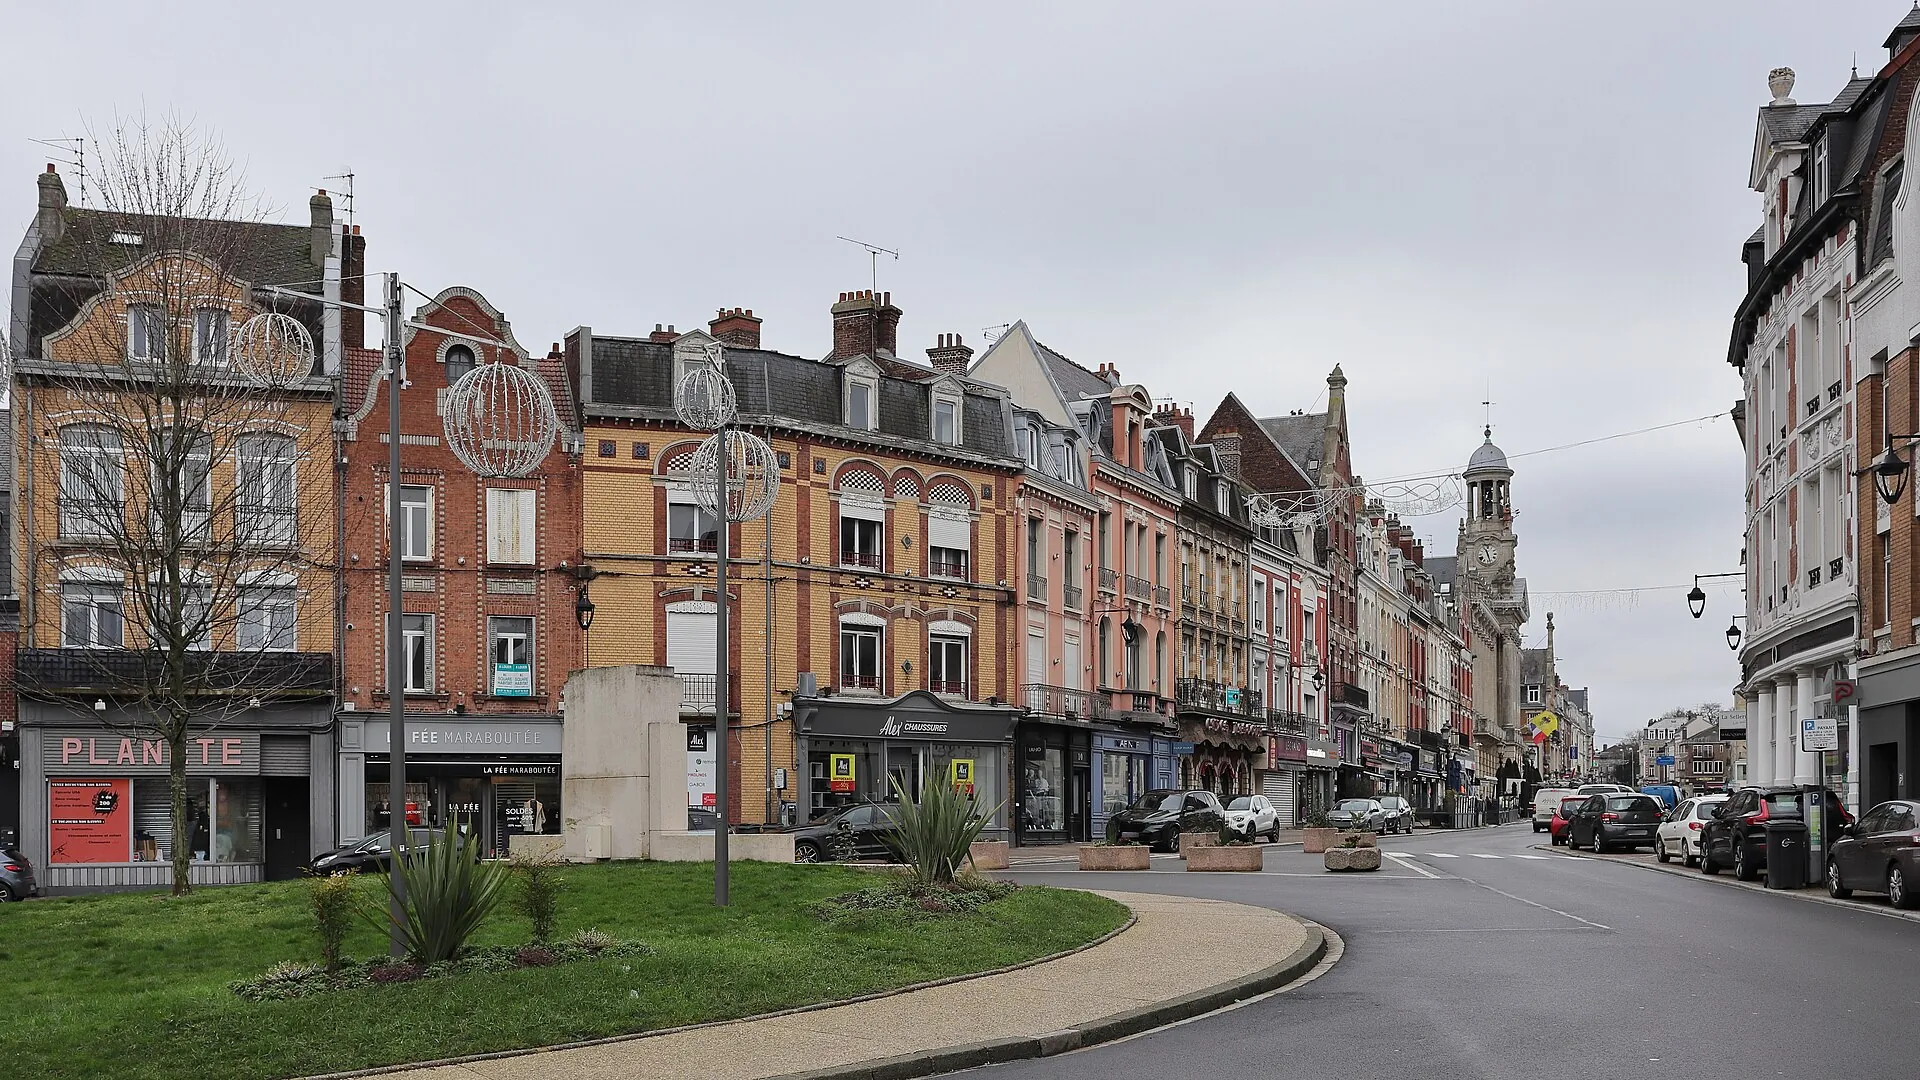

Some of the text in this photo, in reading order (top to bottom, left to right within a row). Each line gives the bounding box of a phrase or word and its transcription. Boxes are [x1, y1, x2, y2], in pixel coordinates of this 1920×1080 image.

[879, 716, 948, 736] Alex CHAUSSURES
[412, 728, 438, 744] FÉE
[444, 730, 541, 744] MARABOUTÉE
[495, 765, 508, 774] FÉE
[510, 766, 556, 774] MARABOUTÉE
[1812, 793, 1819, 804] P
[463, 802, 479, 810] FÉE
